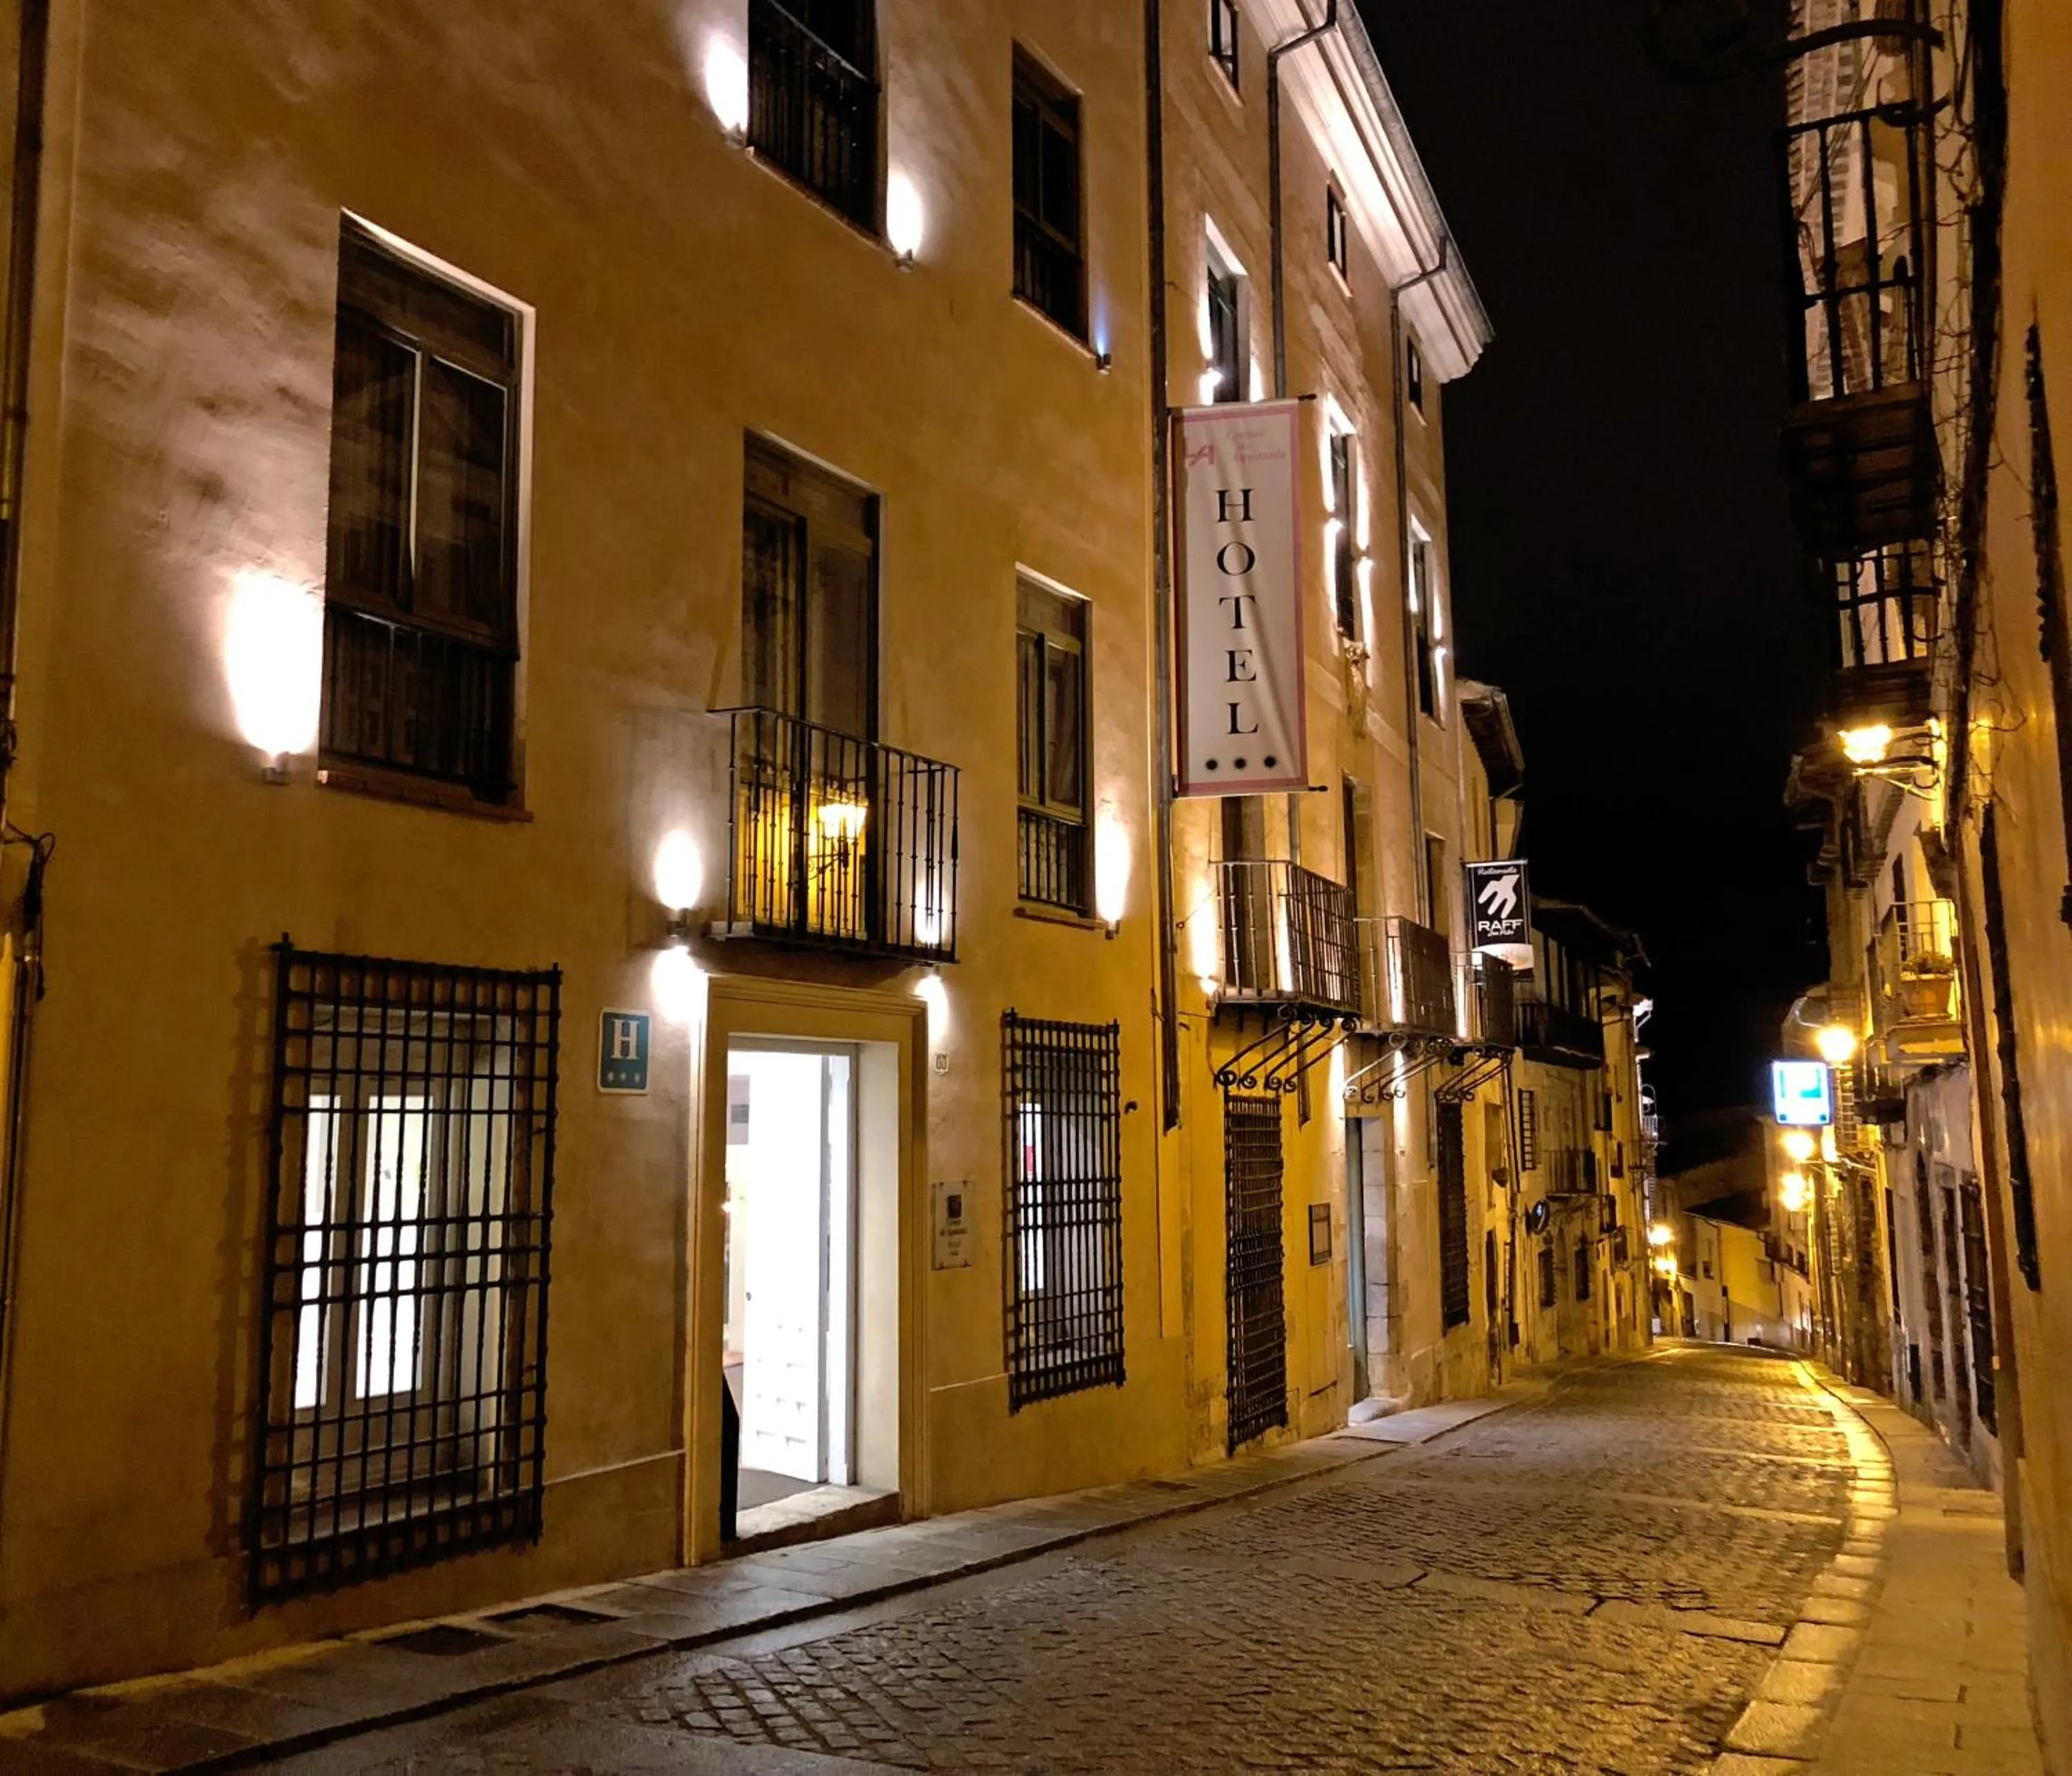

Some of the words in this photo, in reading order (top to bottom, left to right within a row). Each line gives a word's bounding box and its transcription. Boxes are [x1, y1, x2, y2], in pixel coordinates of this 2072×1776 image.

[1216, 488, 1259, 736] HOTEL
[1477, 918, 1524, 932] RAFF
[611, 1018, 640, 1060] H
